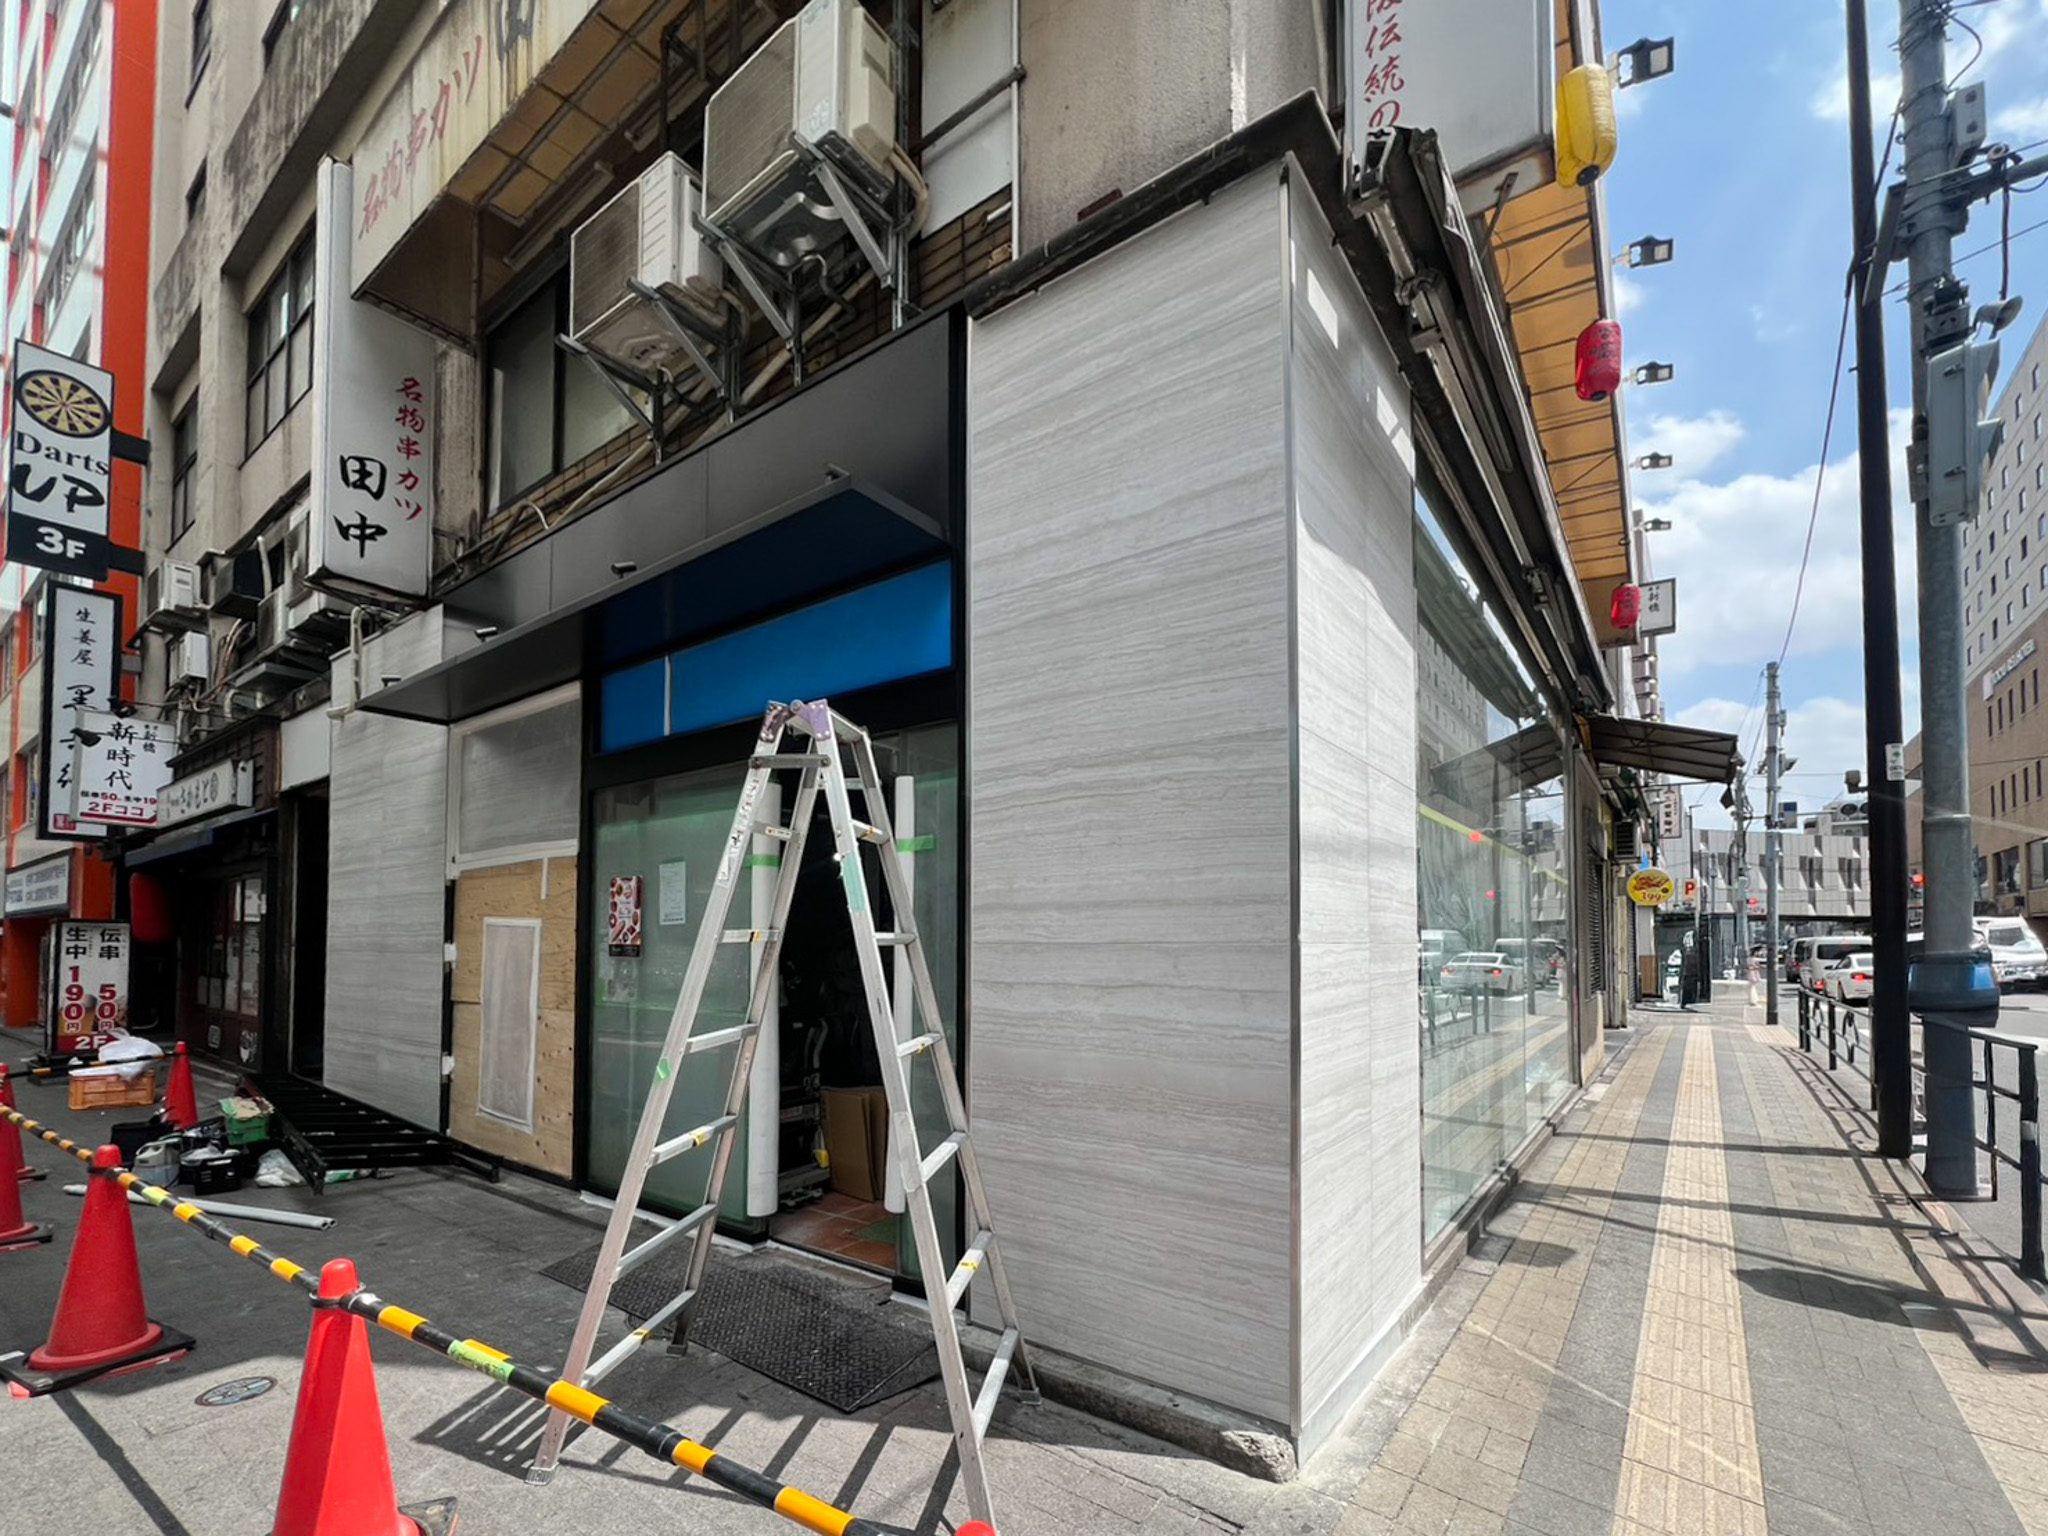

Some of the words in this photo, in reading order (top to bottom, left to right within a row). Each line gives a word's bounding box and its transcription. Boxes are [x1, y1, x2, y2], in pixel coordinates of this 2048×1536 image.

[14, 431, 110, 477] Darts
[394, 377, 425, 521] 名物串カツ
[12, 462, 105, 513] UP
[333, 454, 388, 559] 田中
[35, 526, 86, 559] 3F
[71, 607, 97, 668] 生姜屋
[104, 721, 139, 791] 新時代
[88, 801, 145, 817] 2Fココ
[98, 927, 121, 960] 伝串
